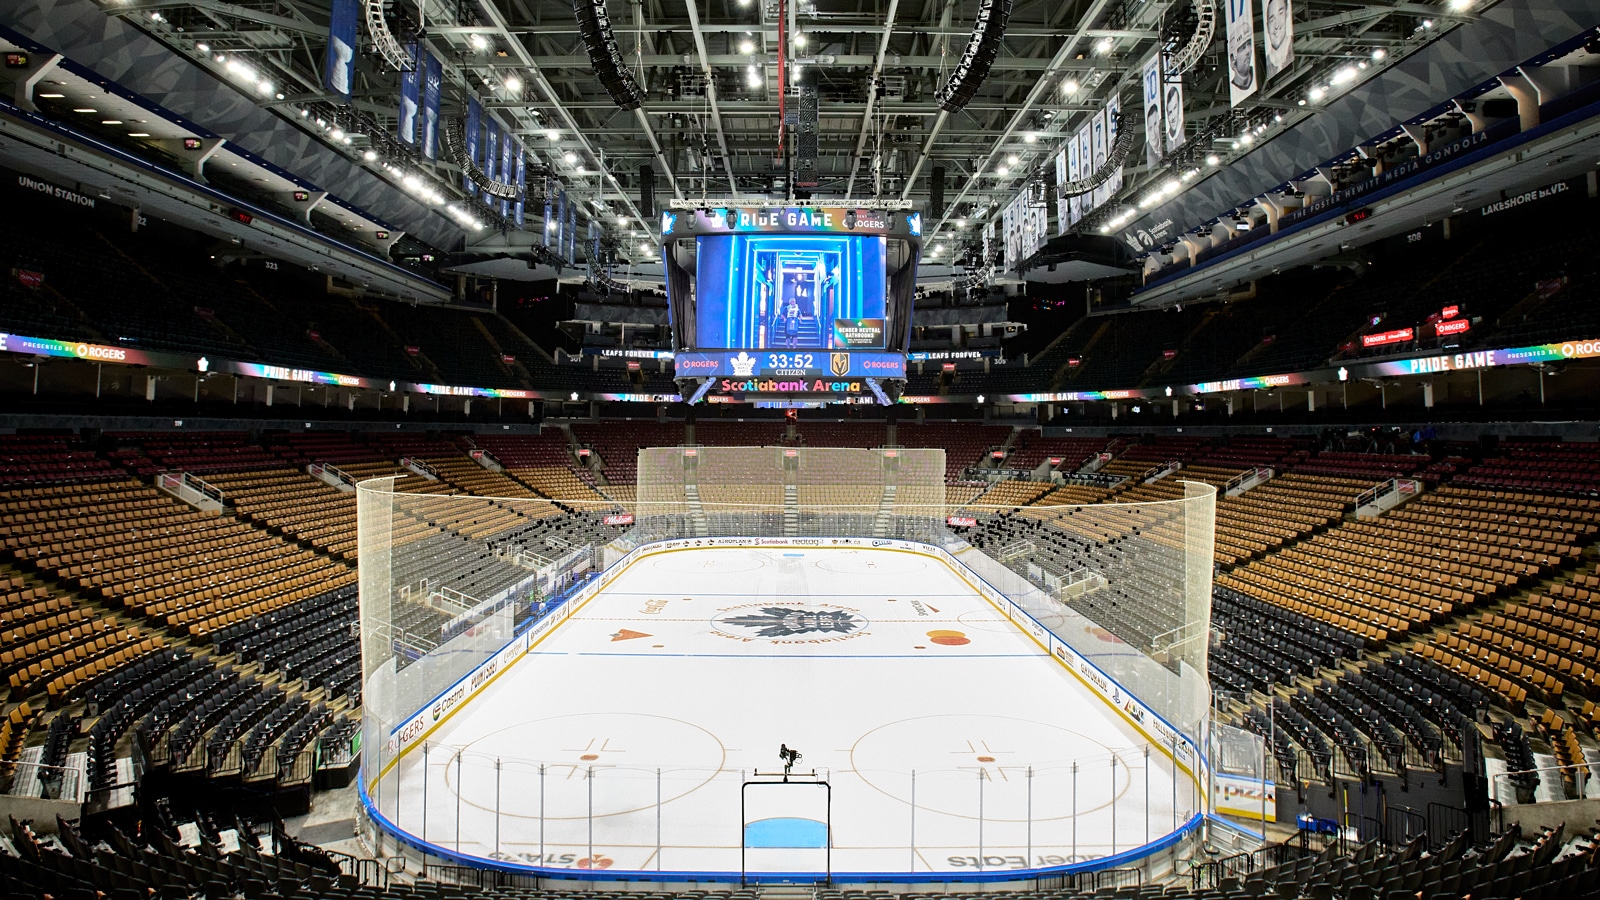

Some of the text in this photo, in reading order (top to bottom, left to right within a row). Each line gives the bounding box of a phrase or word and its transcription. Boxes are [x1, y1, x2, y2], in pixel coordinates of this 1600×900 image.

[1146, 70, 1157, 103] 10
[1293, 131, 1487, 220] THE FOSTER HEWITT MEDIA GONDOLA
[19, 176, 95, 208] UNION STATION
[1482, 190, 1537, 216] LAKESHORE
[741, 213, 833, 227] RIDE GAME
[265, 261, 278, 271] 323
[1445, 323, 1466, 331] ROGERS
[22, 341, 62, 351] PRESENTED
[88, 346, 126, 360] ROGERS
[602, 349, 623, 357] LEAFS
[625, 350, 655, 358] FOREVER
[1507, 348, 1558, 359] PRESENTED BY
[691, 360, 719, 368] ROGERS
[768, 354, 813, 369] 33:52
[871, 360, 899, 368] ROGERS
[1410, 350, 1496, 374] PRIDE GAME
[263, 365, 314, 382] PRIDE GAME
[343, 377, 360, 386] ROGERS
[721, 379, 861, 392] Scotiabank Arena
[1203, 379, 1241, 393] PRIDE GAME
[1270, 375, 1289, 385] ROGERS
[430, 384, 451, 395] PRIDE
[453, 386, 474, 396] GAME
[624, 394, 649, 402] PRIDE
[1031, 393, 1054, 401] PRIDE
[1056, 392, 1079, 400] GAME
[606, 515, 633, 525] Molson
[949, 516, 975, 526] Molson
[441, 685, 465, 713] Castrol
[947, 854, 1029, 870] Eats
